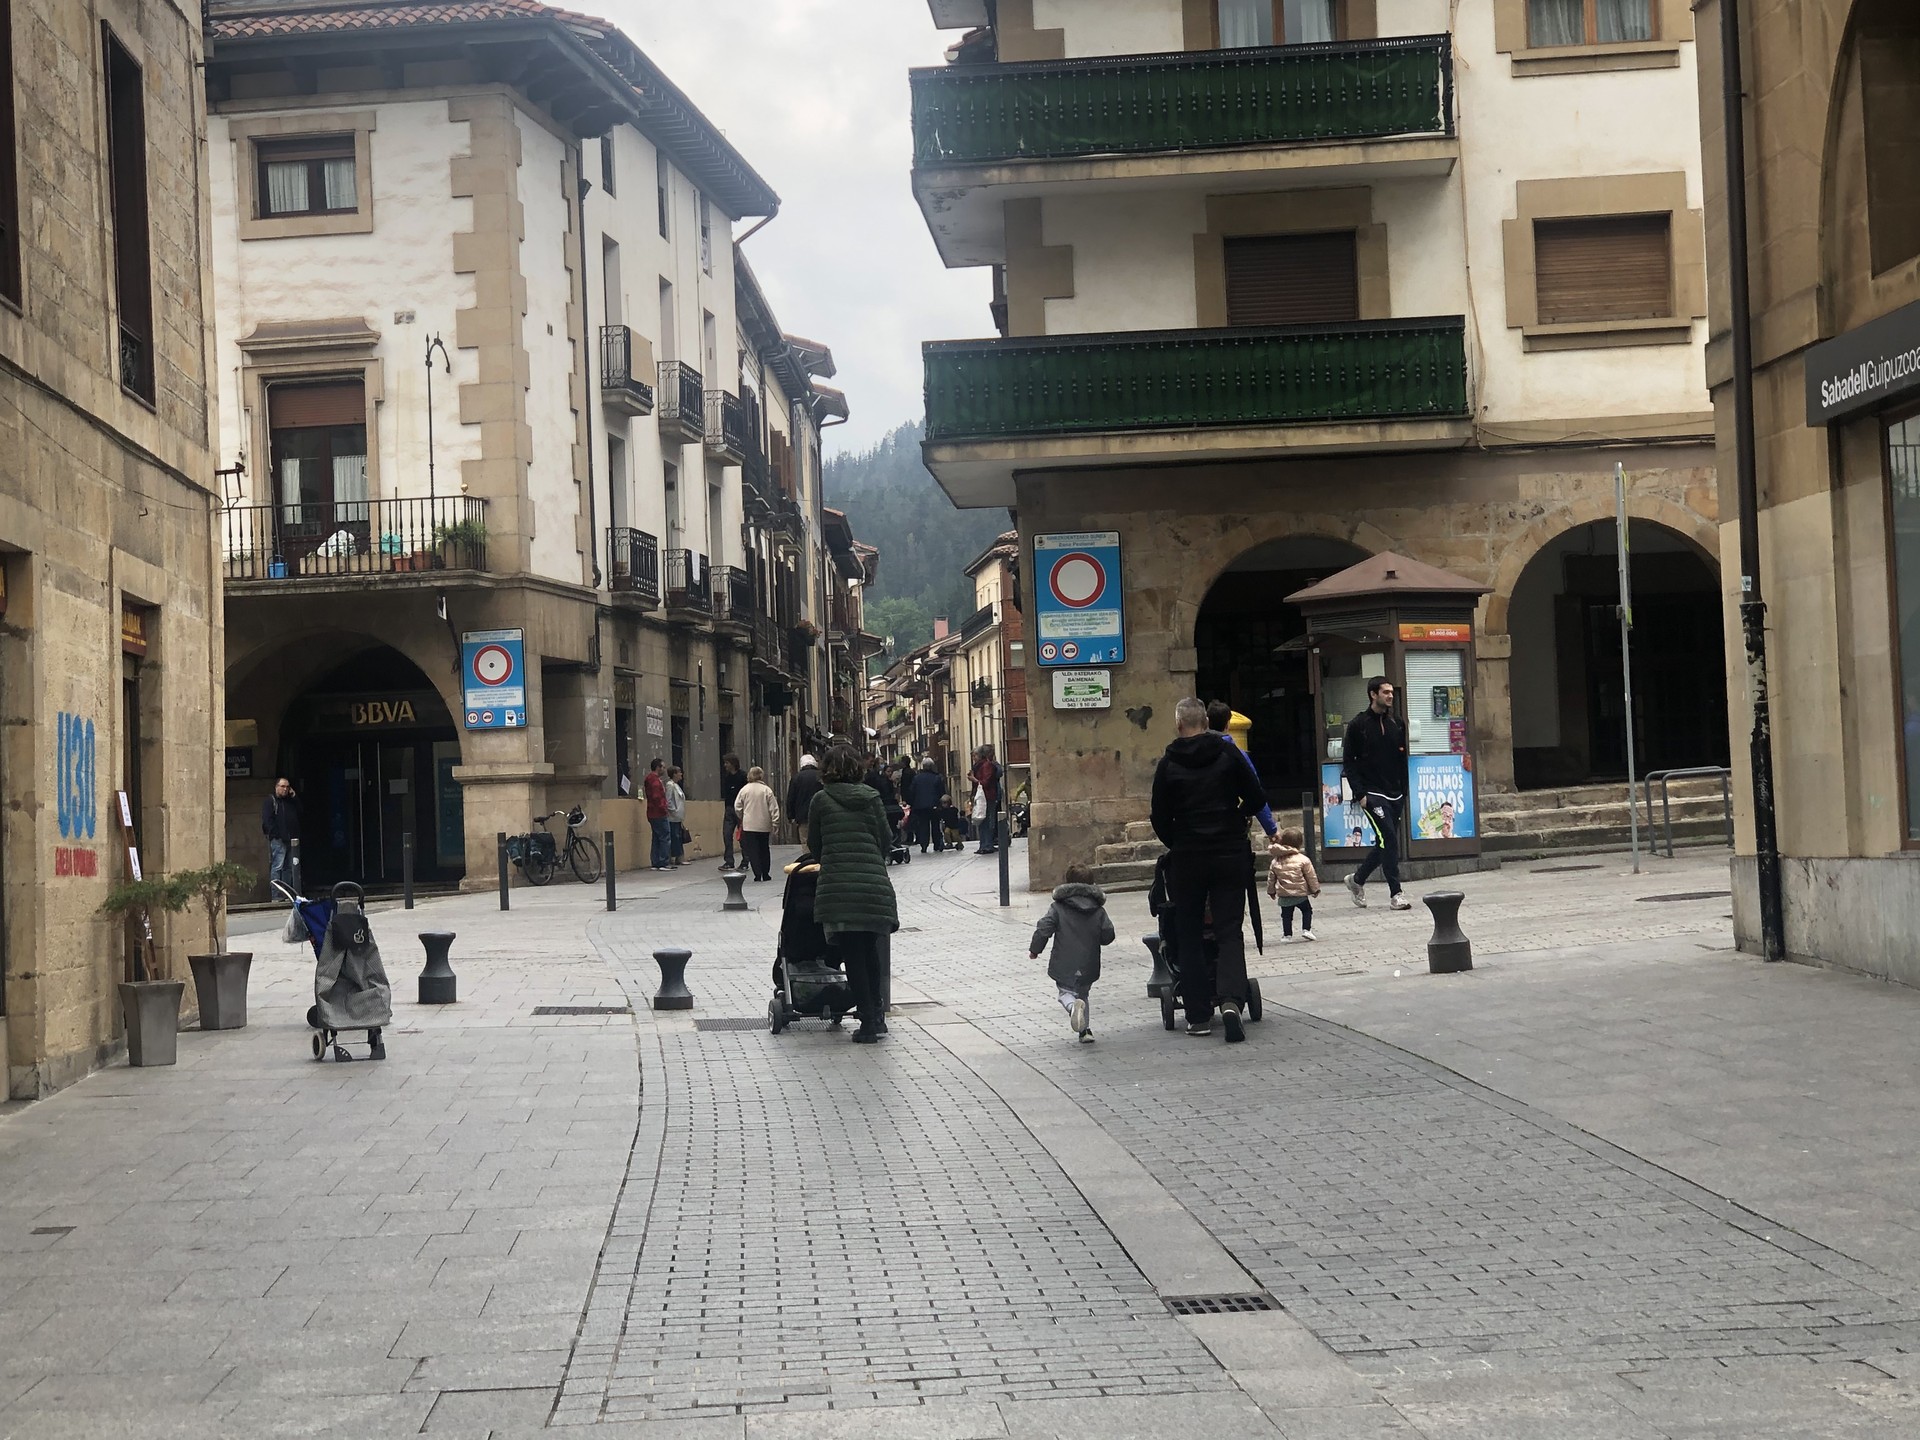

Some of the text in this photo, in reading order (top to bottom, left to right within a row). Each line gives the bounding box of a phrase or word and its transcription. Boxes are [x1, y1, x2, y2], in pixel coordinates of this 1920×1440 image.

[351, 700, 416, 724] BBVA
[227, 755, 247, 763] BBVA
[1417, 774, 1464, 791] JUGAMOS
[1417, 791, 1465, 814] TODOS
[1343, 814, 1372, 829] TODO
